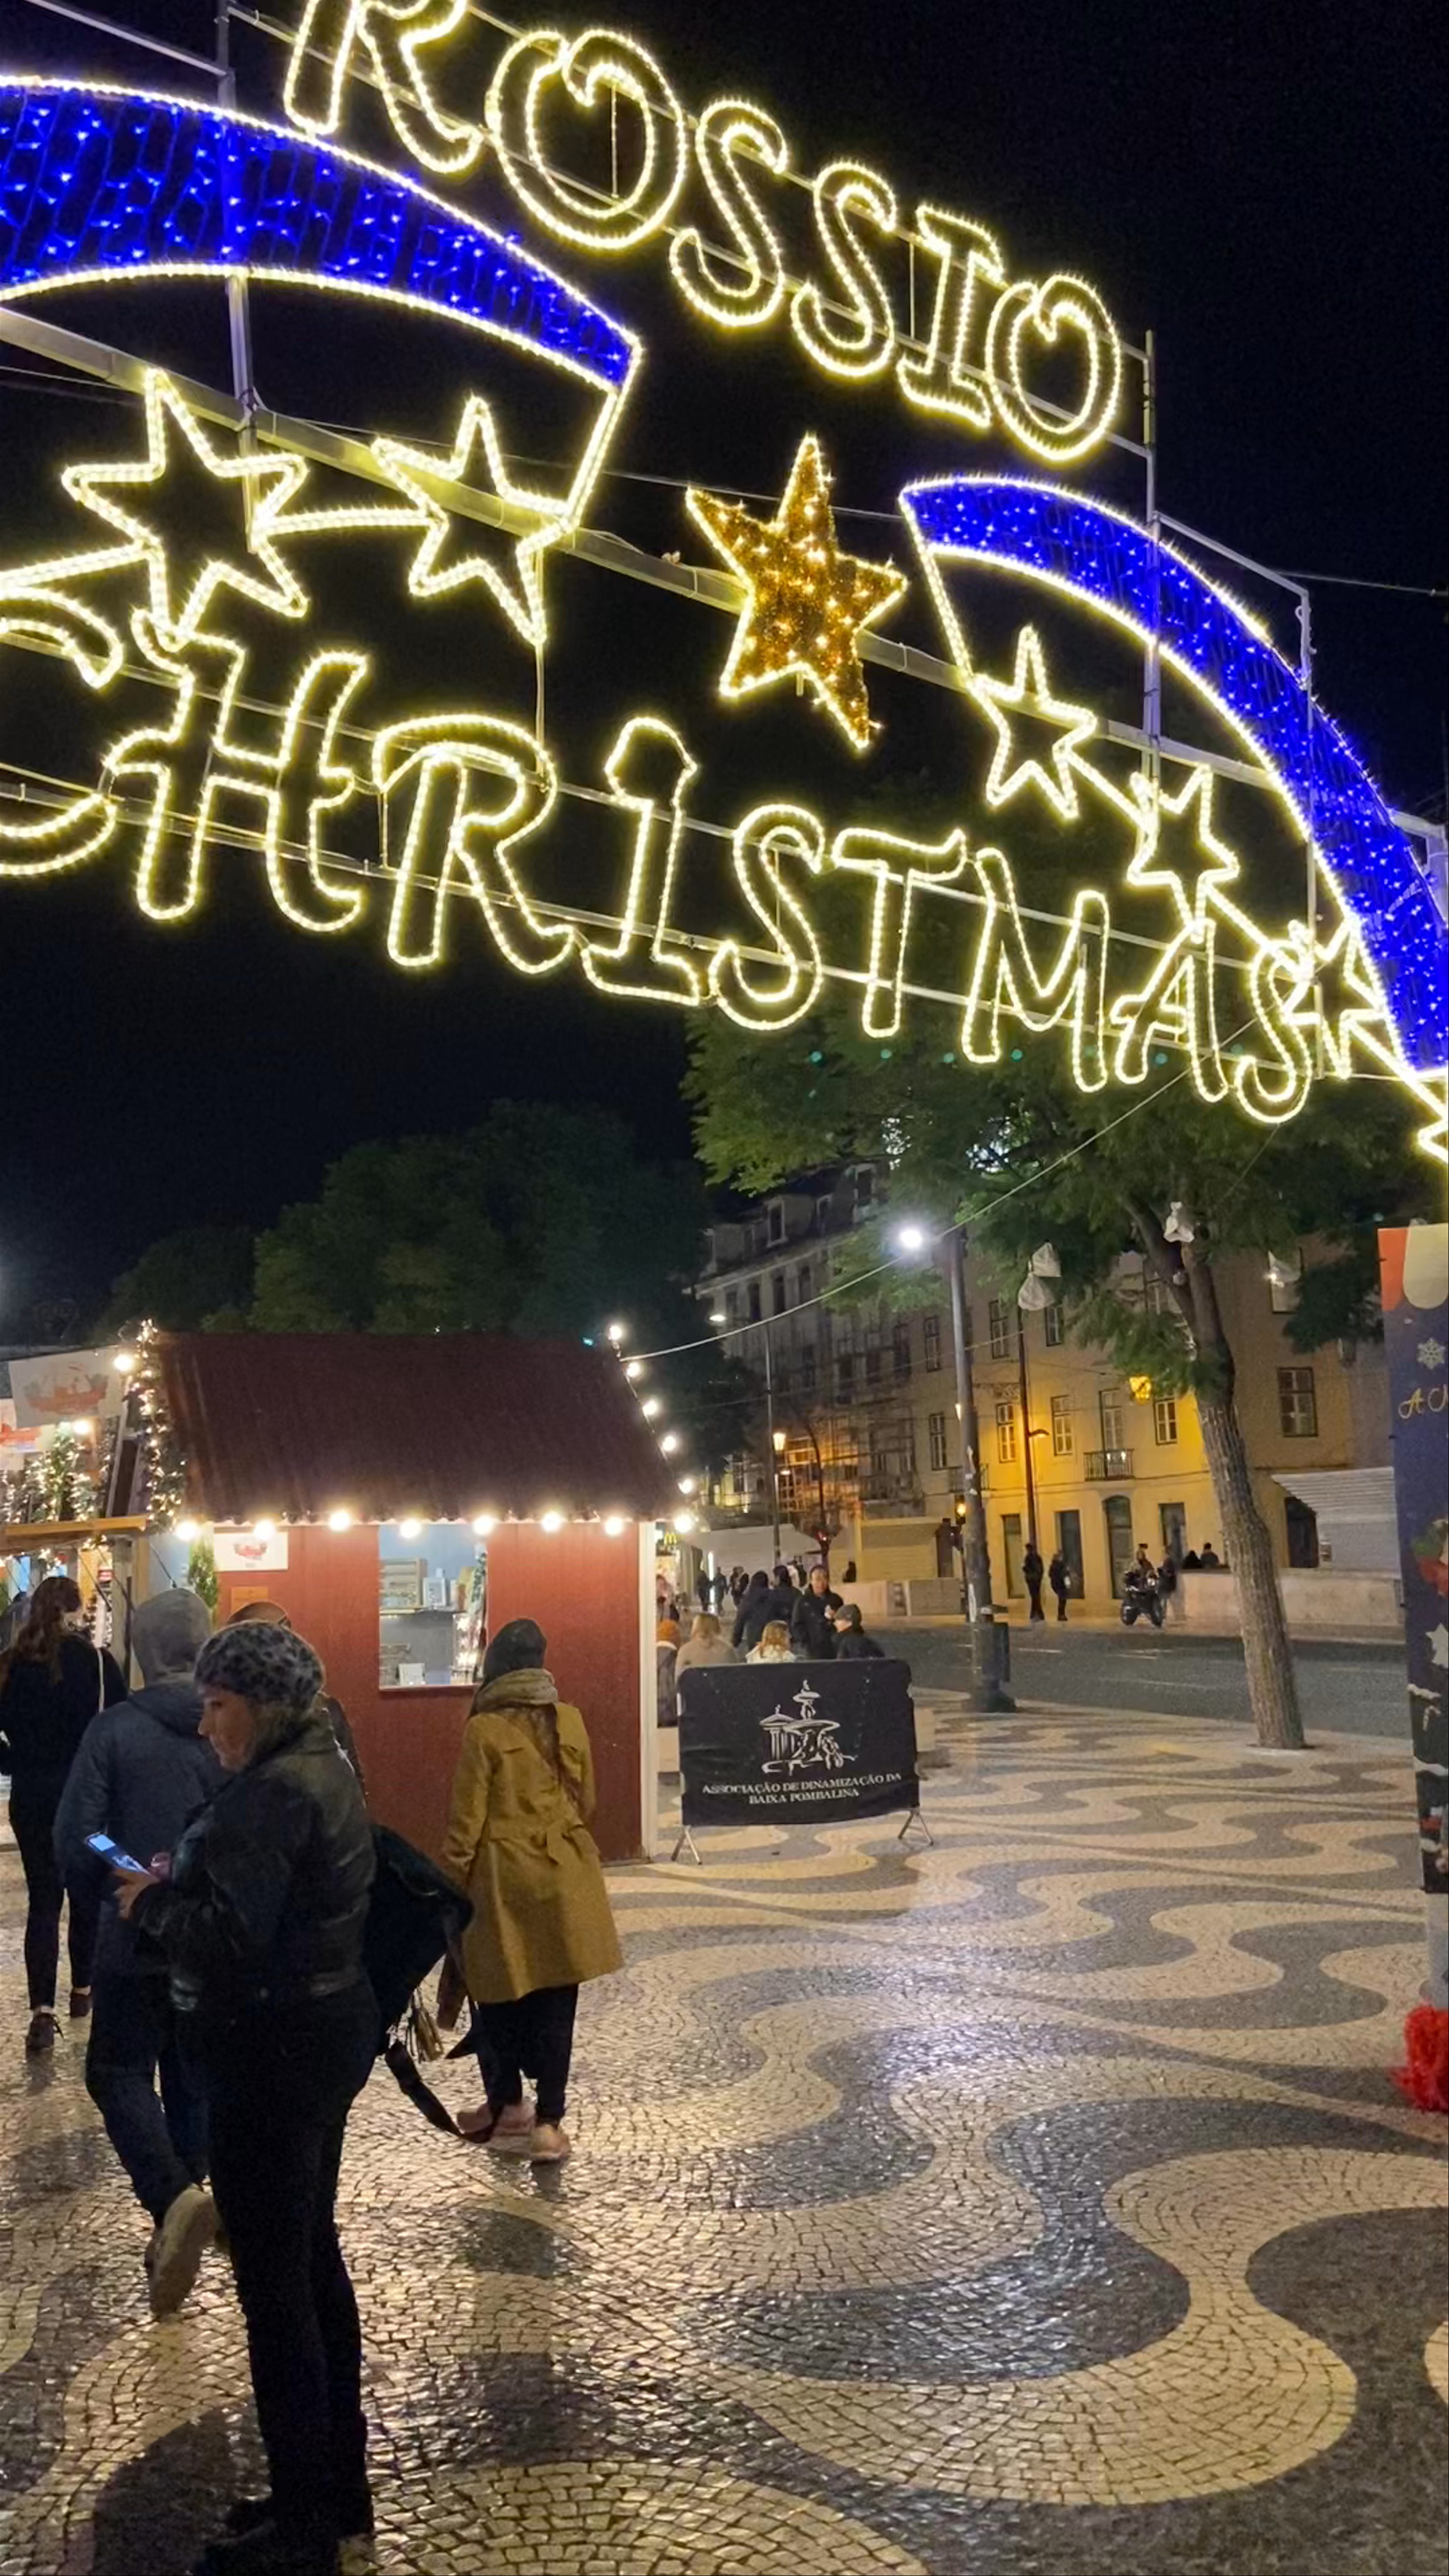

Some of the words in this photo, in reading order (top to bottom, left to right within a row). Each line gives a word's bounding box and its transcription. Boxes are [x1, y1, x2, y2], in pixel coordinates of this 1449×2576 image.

[283, 0, 1121, 461] ROSSIO
[702, 1781, 781, 1794] ASSOCIAÇÃO
[783, 1781, 800, 1792] DE
[801, 1773, 884, 1790] DINAMIZAÇÃO
[886, 1772, 901, 1782] DA
[749, 1794, 787, 1804] BAIXA
[789, 1788, 859, 1802] POMBALINA
